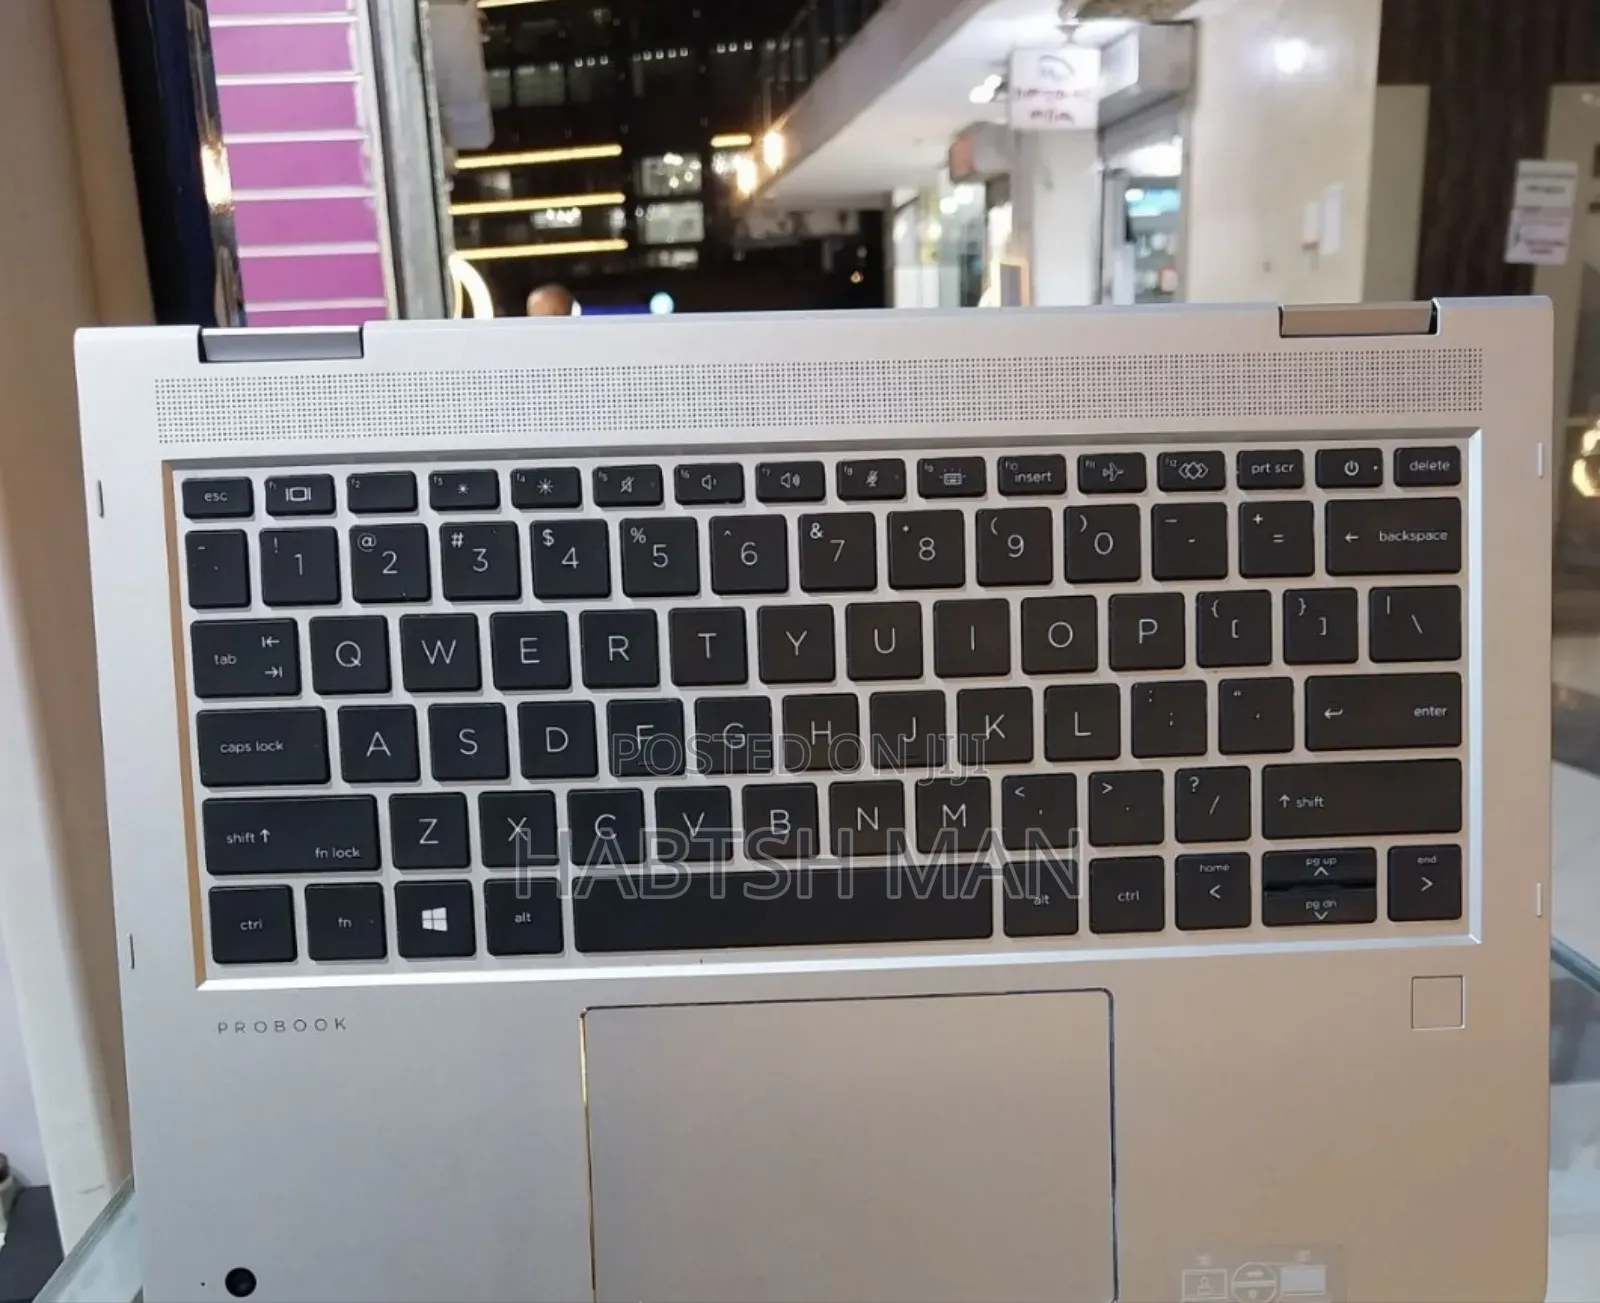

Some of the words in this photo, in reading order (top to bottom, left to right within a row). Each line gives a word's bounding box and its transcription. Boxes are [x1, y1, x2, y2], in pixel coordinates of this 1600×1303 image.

[1251, 463, 1270, 474] prt
[1275, 463, 1294, 473] scr
[1409, 460, 1450, 471] delete
[1014, 471, 1052, 483] insert
[204, 492, 228, 502] esc
[990, 517, 998, 535] (
[1079, 514, 1088, 533] )
[1253, 513, 1263, 524] +
[451, 532, 464, 548] #
[542, 528, 555, 547] $
[629, 527, 647, 544] %
[809, 522, 823, 539] &
[1273, 534, 1284, 543] =
[1379, 530, 1448, 542] backspace
[273, 537, 278, 553] !
[357, 532, 377, 552] @
[830, 539, 846, 562] 7
[918, 536, 936, 561] 8
[1007, 534, 1025, 558] 9
[294, 553, 303, 575] 1
[382, 550, 398, 574] 2
[472, 548, 489, 572] 3
[561, 546, 579, 569] 4
[652, 543, 669, 568] 5
[740, 542, 758, 566] 6
[1210, 599, 1219, 618] {
[1298, 597, 1307, 616] }
[1139, 618, 1158, 644] P
[1231, 619, 1239, 639] [
[1319, 617, 1327, 636] ]
[1411, 614, 1423, 634] \
[785, 630, 808, 656] Y
[874, 627, 896, 654] U
[1048, 621, 1074, 648] O
[335, 640, 361, 668] Q
[421, 639, 457, 665] W
[519, 637, 541, 664] E
[608, 635, 630, 662] R
[697, 632, 717, 659] T
[214, 654, 237, 666] tab
[1413, 706, 1447, 717] enter
[811, 720, 832, 745] H
[902, 716, 917, 743] J
[985, 714, 1006, 739] K
[1074, 711, 1092, 737] L
[366, 731, 391, 757] A
[459, 728, 478, 755] S
[545, 726, 569, 753] D
[635, 724, 654, 751] F
[722, 723, 746, 749] G
[219, 743, 252, 754] caps
[255, 740, 284, 752] lock
[1014, 786, 1025, 797] <
[1102, 782, 1113, 794] >
[1189, 776, 1200, 793] ?
[1209, 795, 1220, 815] /
[1296, 795, 1324, 808] shift
[682, 812, 705, 838] V
[769, 809, 791, 835] B
[857, 806, 879, 831] N
[942, 804, 966, 828] M
[419, 818, 439, 845] Z
[507, 816, 528, 842] X
[594, 814, 617, 840] C
[226, 832, 255, 844] shift
[315, 847, 328, 859] fn
[332, 846, 360, 859] lock
[1305, 857, 1320, 866] pg
[1322, 857, 1337, 866] up
[1417, 855, 1437, 864] end
[1199, 864, 1230, 872] home
[1033, 893, 1049, 906] alt
[1117, 890, 1140, 901] ctrl
[1305, 901, 1320, 910] pg
[1322, 900, 1337, 908] dn
[240, 920, 262, 931] ctrl
[338, 917, 352, 928] fn
[514, 911, 532, 924] alt
[218, 1017, 346, 1034] PROBOOK
